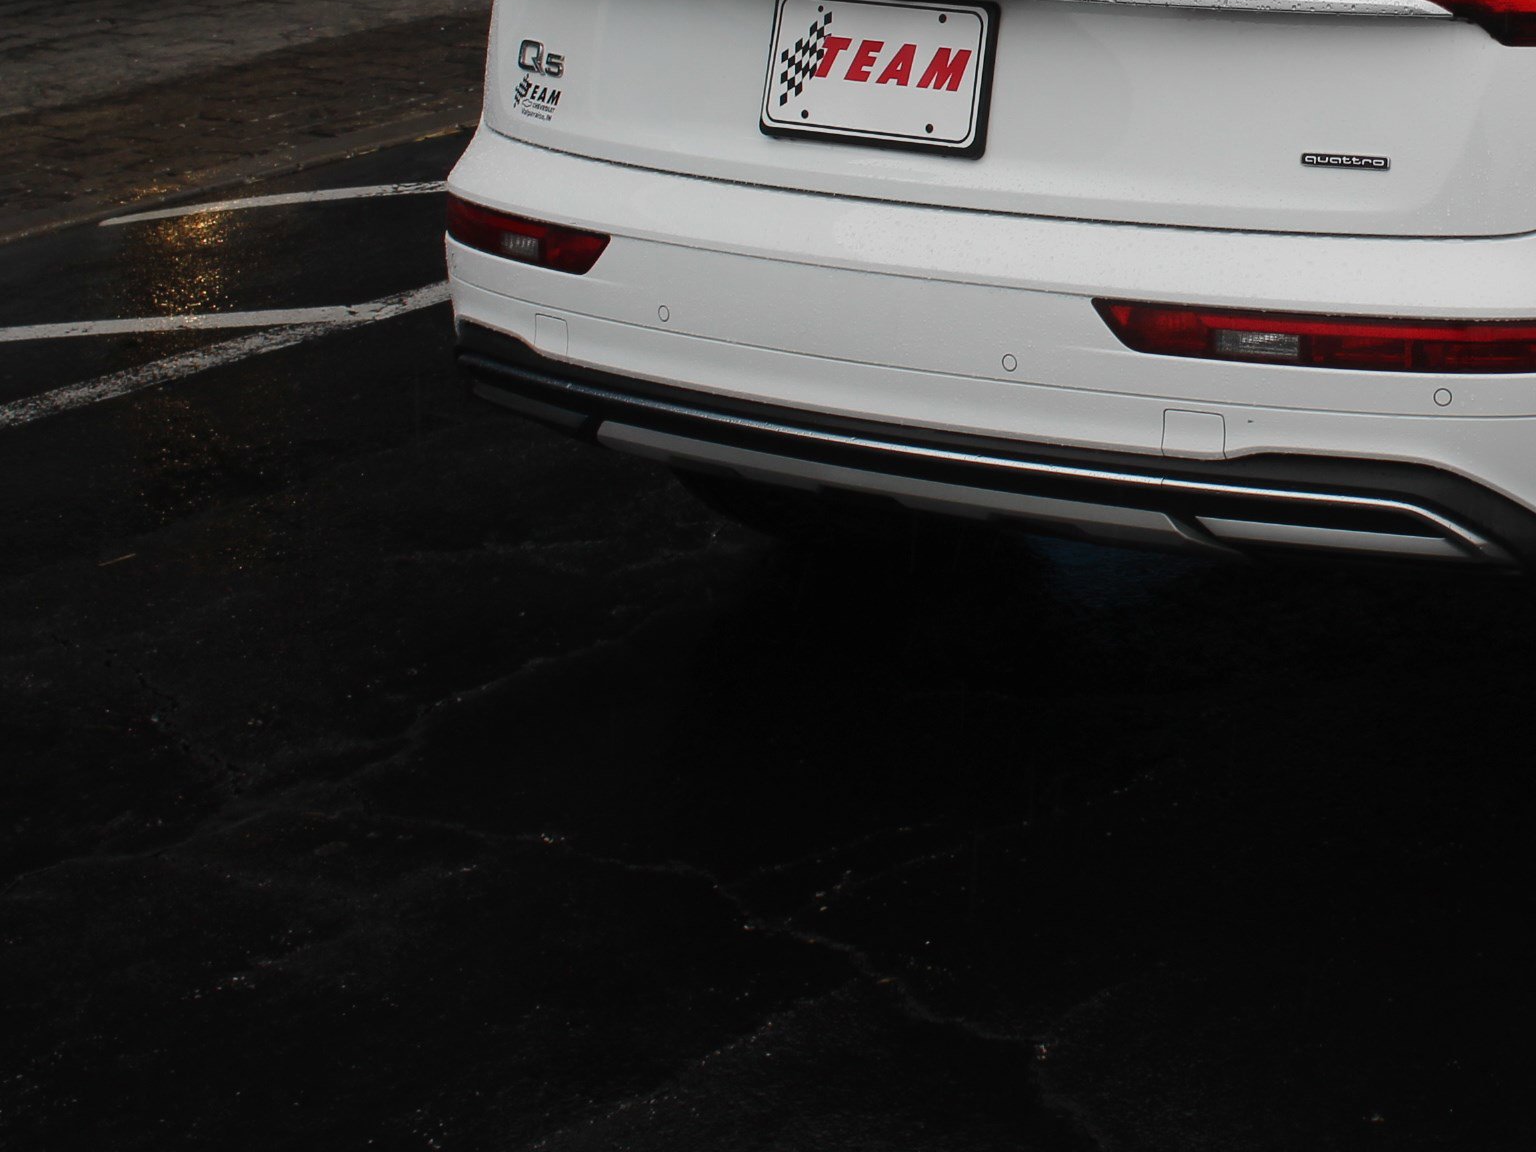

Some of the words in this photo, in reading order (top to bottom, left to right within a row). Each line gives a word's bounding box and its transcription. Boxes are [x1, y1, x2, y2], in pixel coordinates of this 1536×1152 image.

[518, 39, 565, 78] Q5
[814, 35, 972, 92] TEAM
[522, 81, 561, 106] TEAM
[1304, 155, 1384, 167] quattro
